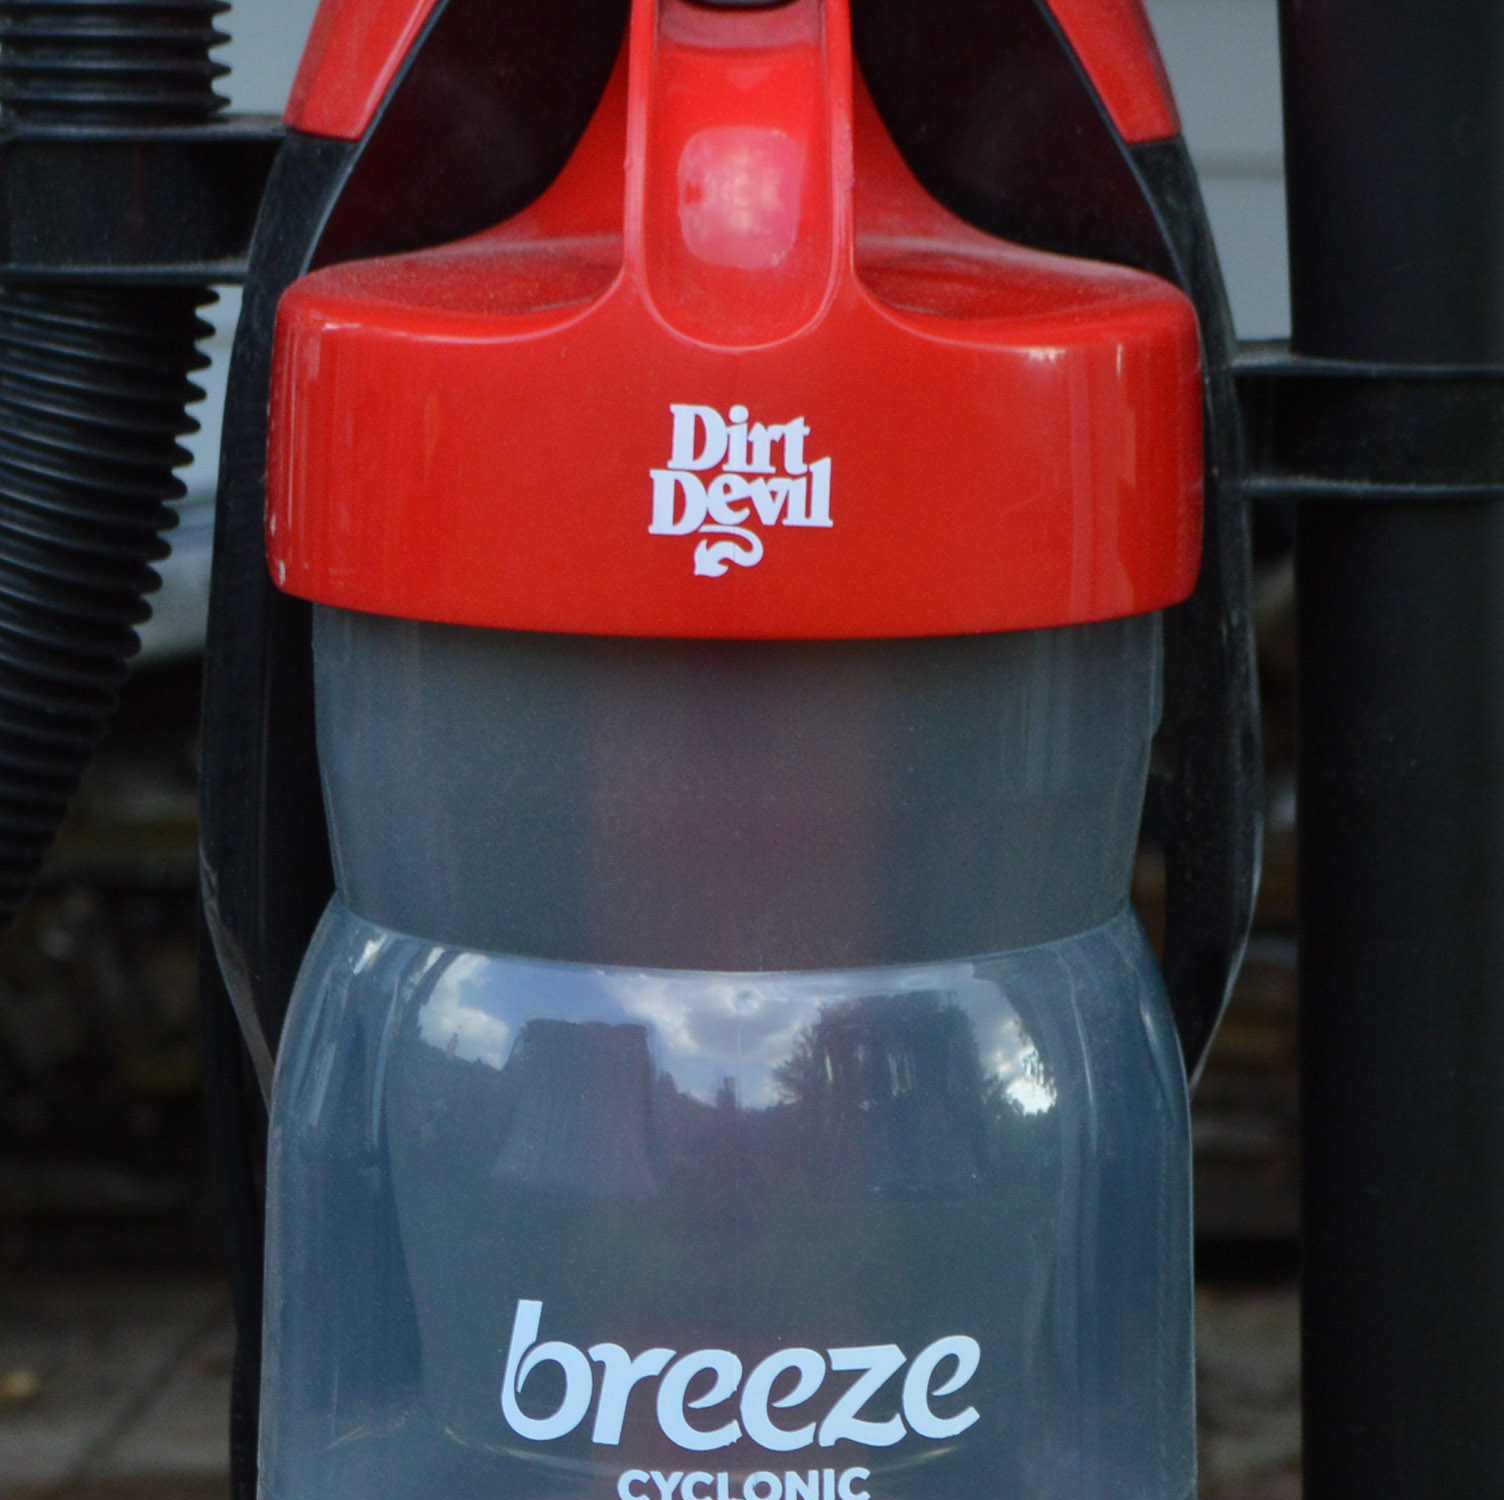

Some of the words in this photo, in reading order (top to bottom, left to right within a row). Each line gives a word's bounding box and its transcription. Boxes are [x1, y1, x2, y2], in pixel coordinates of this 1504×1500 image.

[667, 403, 811, 476] Dirt
[648, 456, 835, 537] Devil
[501, 1299, 982, 1451] breeze
